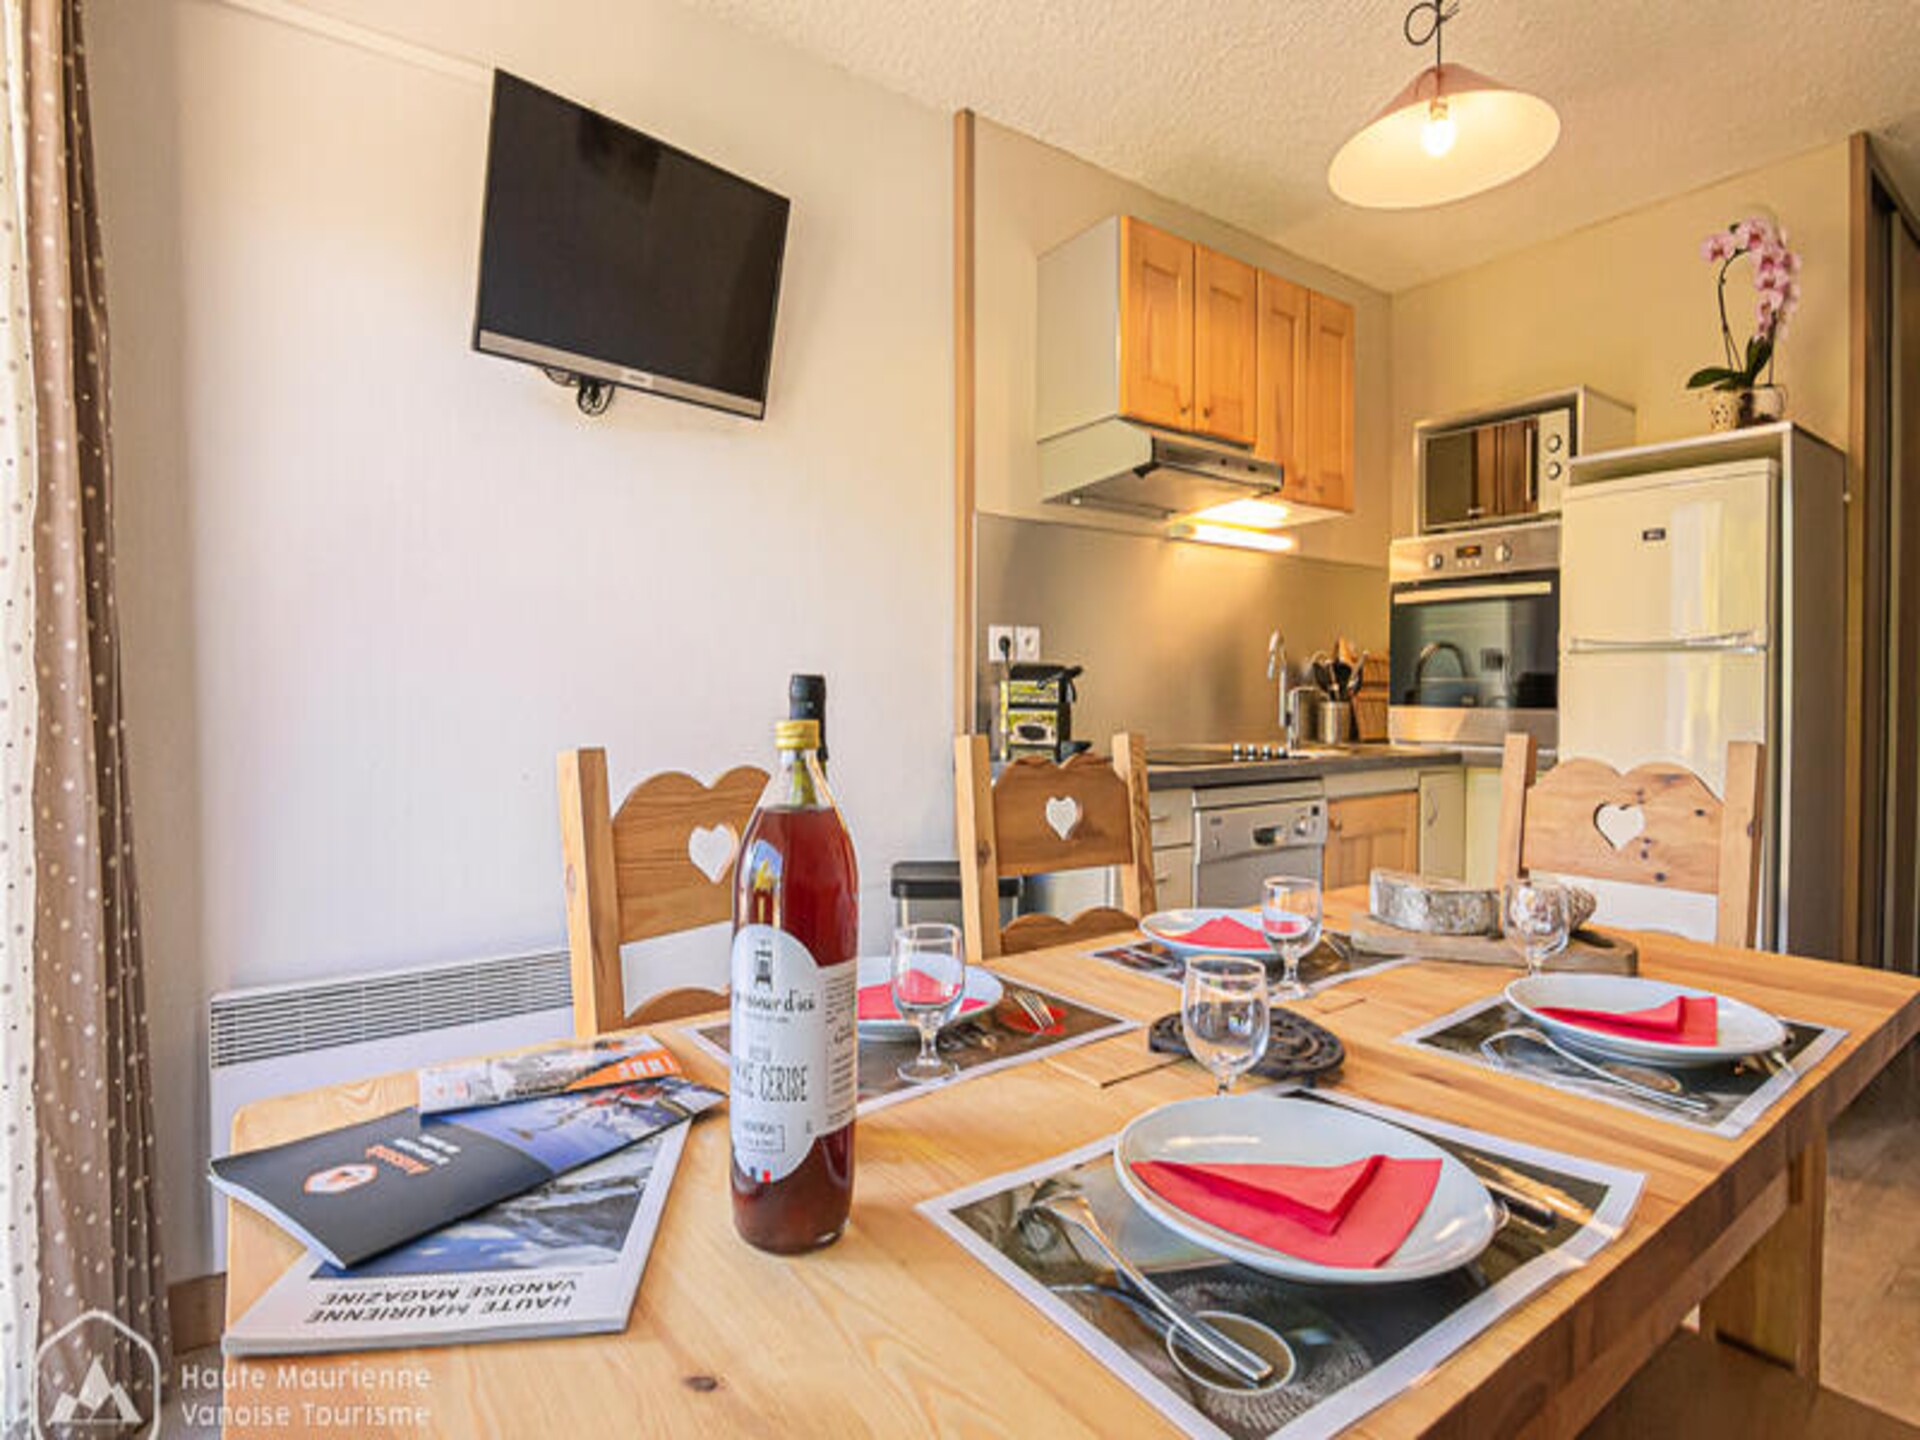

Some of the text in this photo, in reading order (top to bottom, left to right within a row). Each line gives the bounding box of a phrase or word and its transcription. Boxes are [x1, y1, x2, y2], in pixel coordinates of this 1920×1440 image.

[760, 1064, 808, 1102] CERISE
[322, 1287, 461, 1305] MAGAZINE
[468, 1278, 578, 1299] VANOISE
[306, 1296, 574, 1324] HAUTE MAURIENNE
